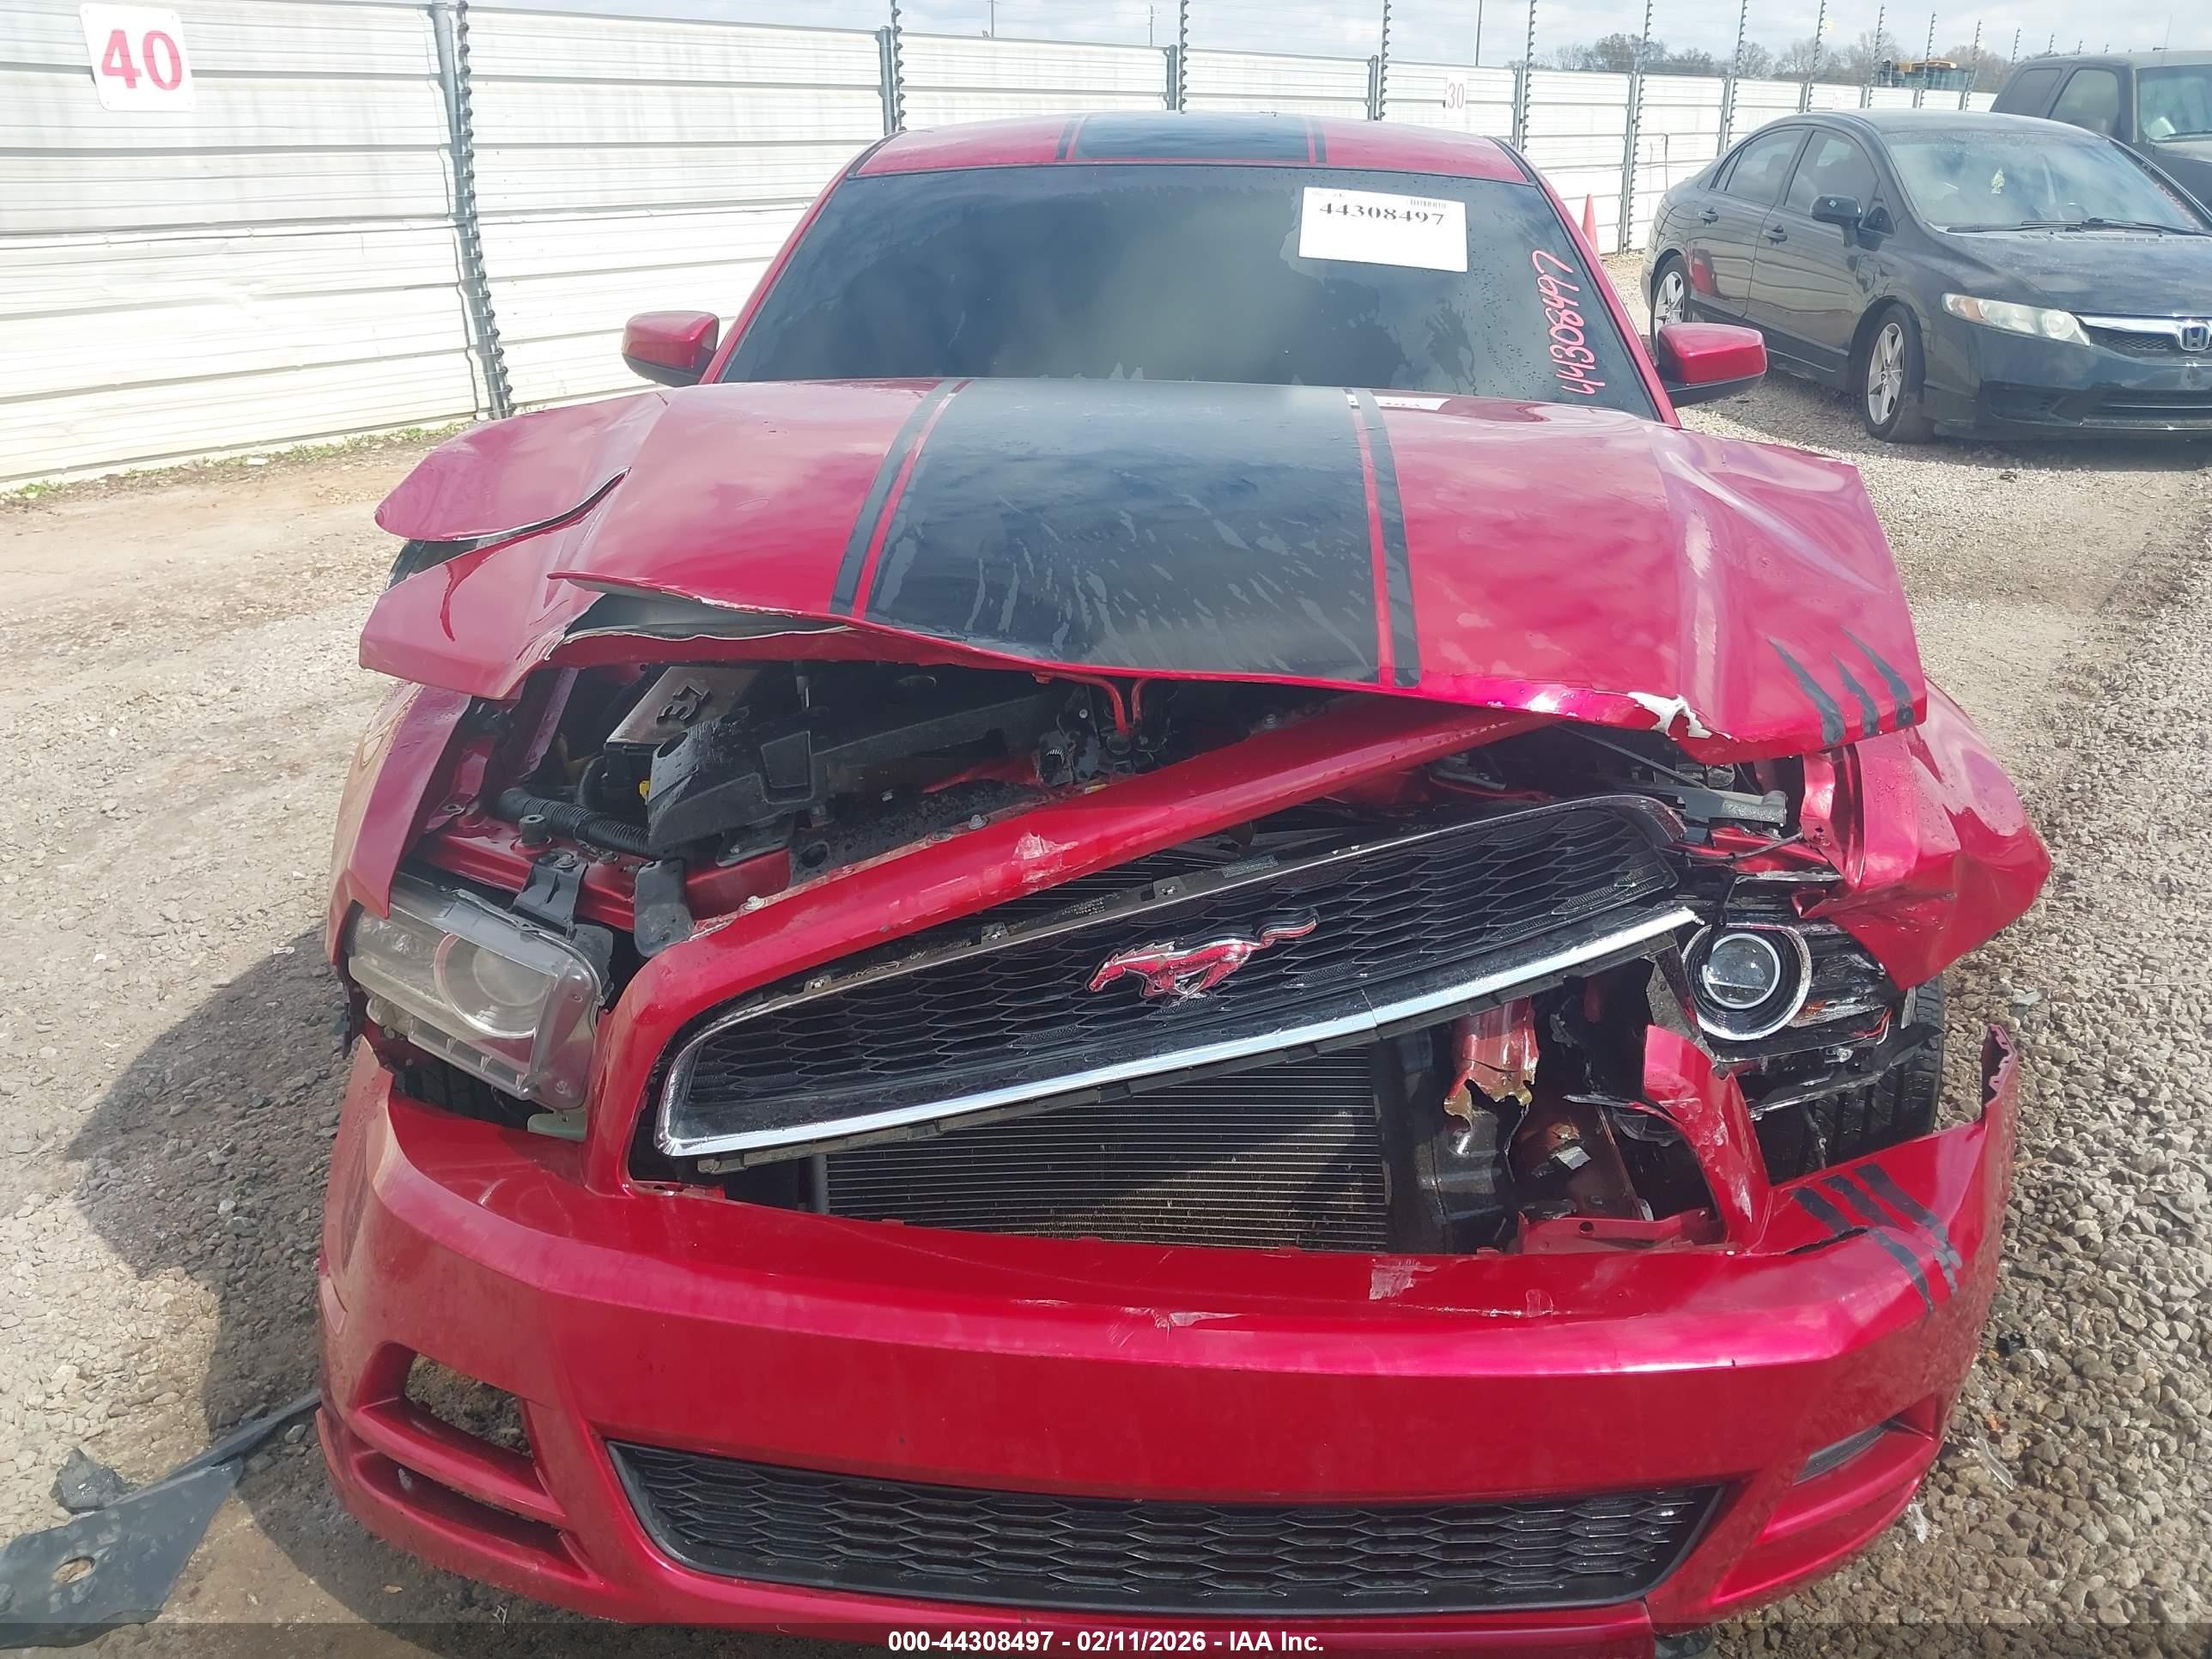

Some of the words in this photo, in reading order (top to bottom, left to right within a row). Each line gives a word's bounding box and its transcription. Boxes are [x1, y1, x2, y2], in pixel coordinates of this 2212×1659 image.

[101, 29, 182, 90] 40
[1447, 82, 1465, 109] 30
[1318, 201, 1446, 225] 44308497
[1532, 249, 1606, 395] 44308497
